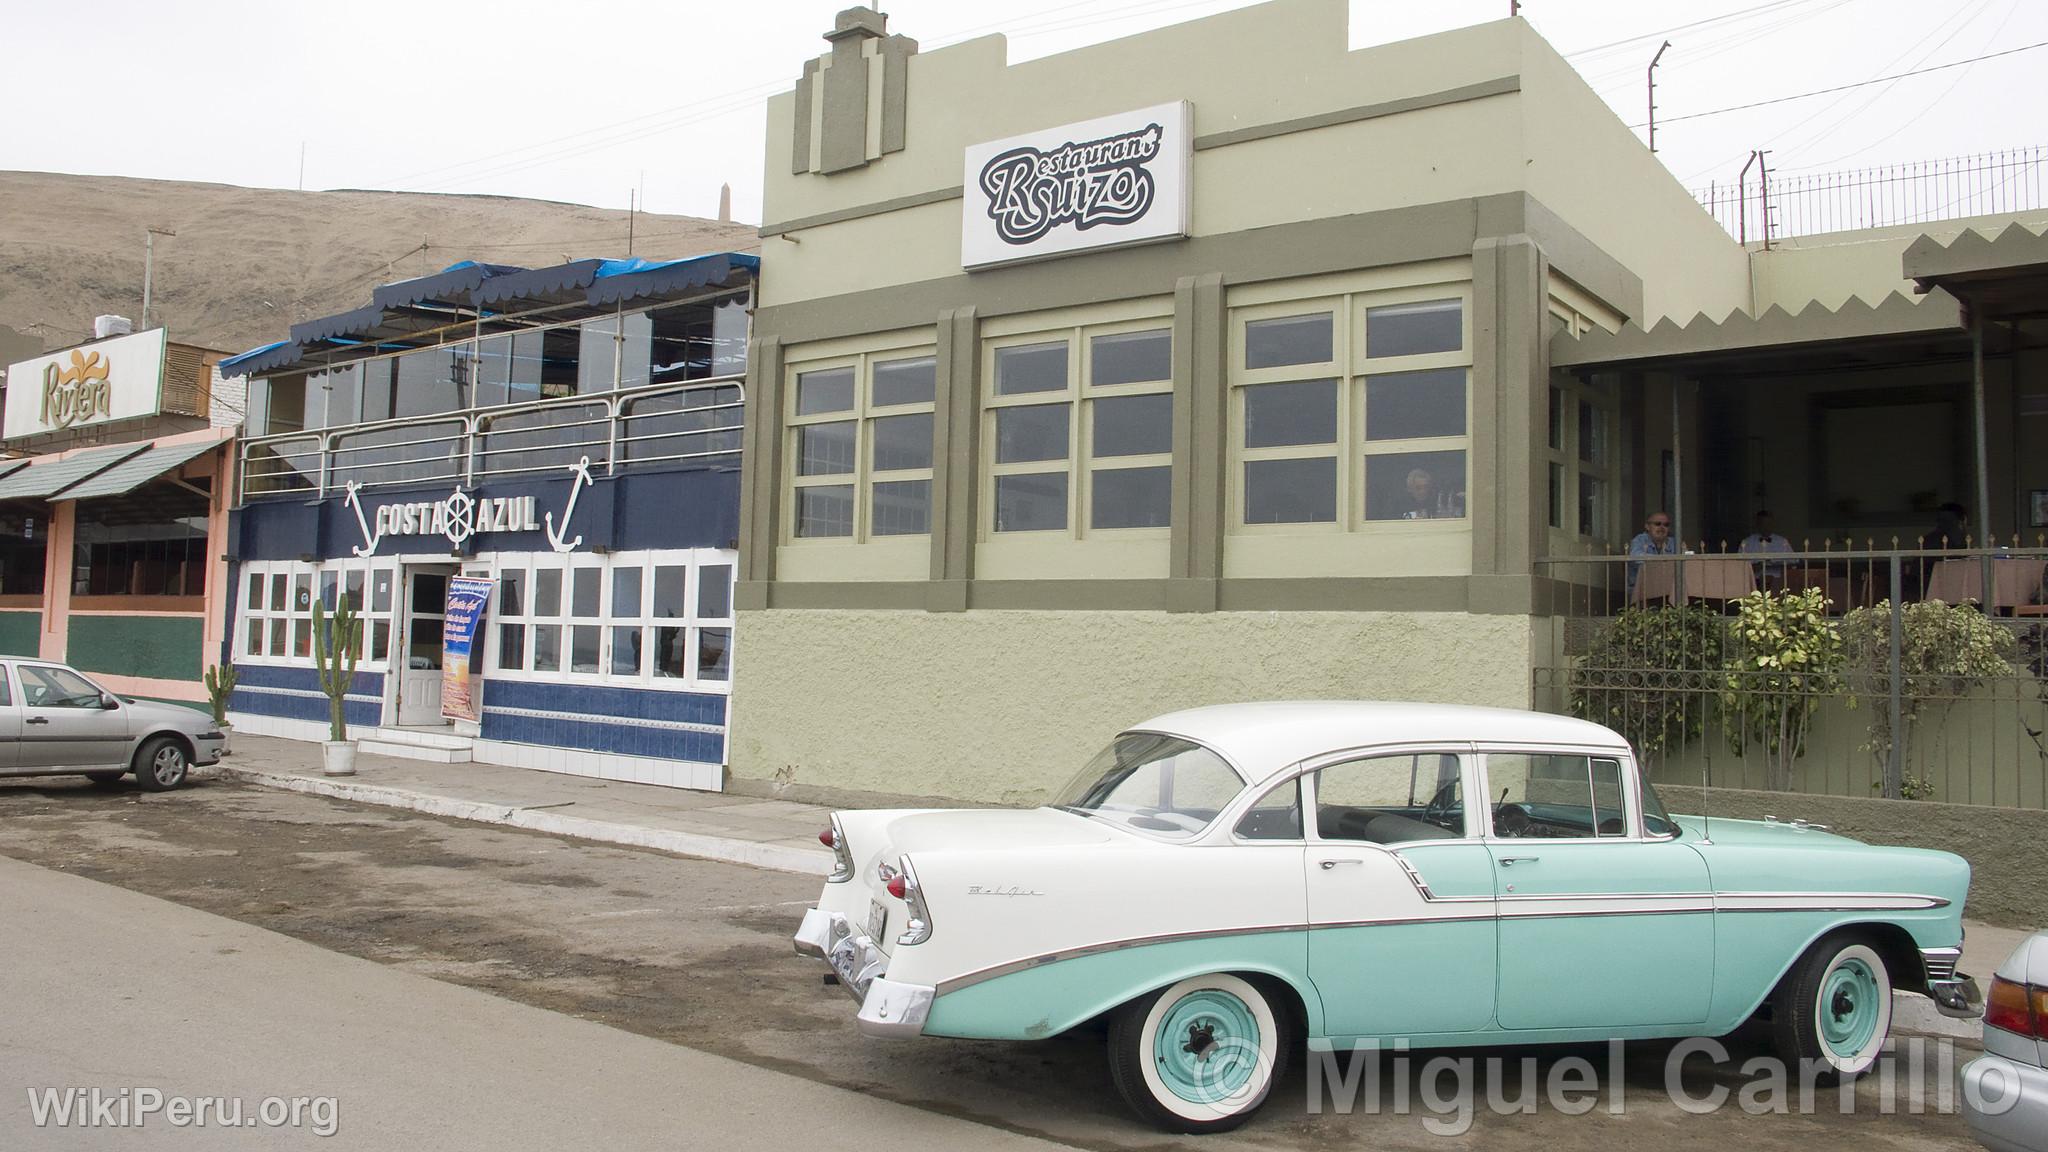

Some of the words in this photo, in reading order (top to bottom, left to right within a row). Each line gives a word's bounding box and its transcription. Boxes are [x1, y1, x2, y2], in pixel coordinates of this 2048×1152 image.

[984, 123, 1163, 225] Restaurant
[1002, 164, 1154, 238] Suizo
[40, 361, 110, 428] Riviera
[377, 501, 449, 536] COSTA
[476, 496, 540, 532] AZUL
